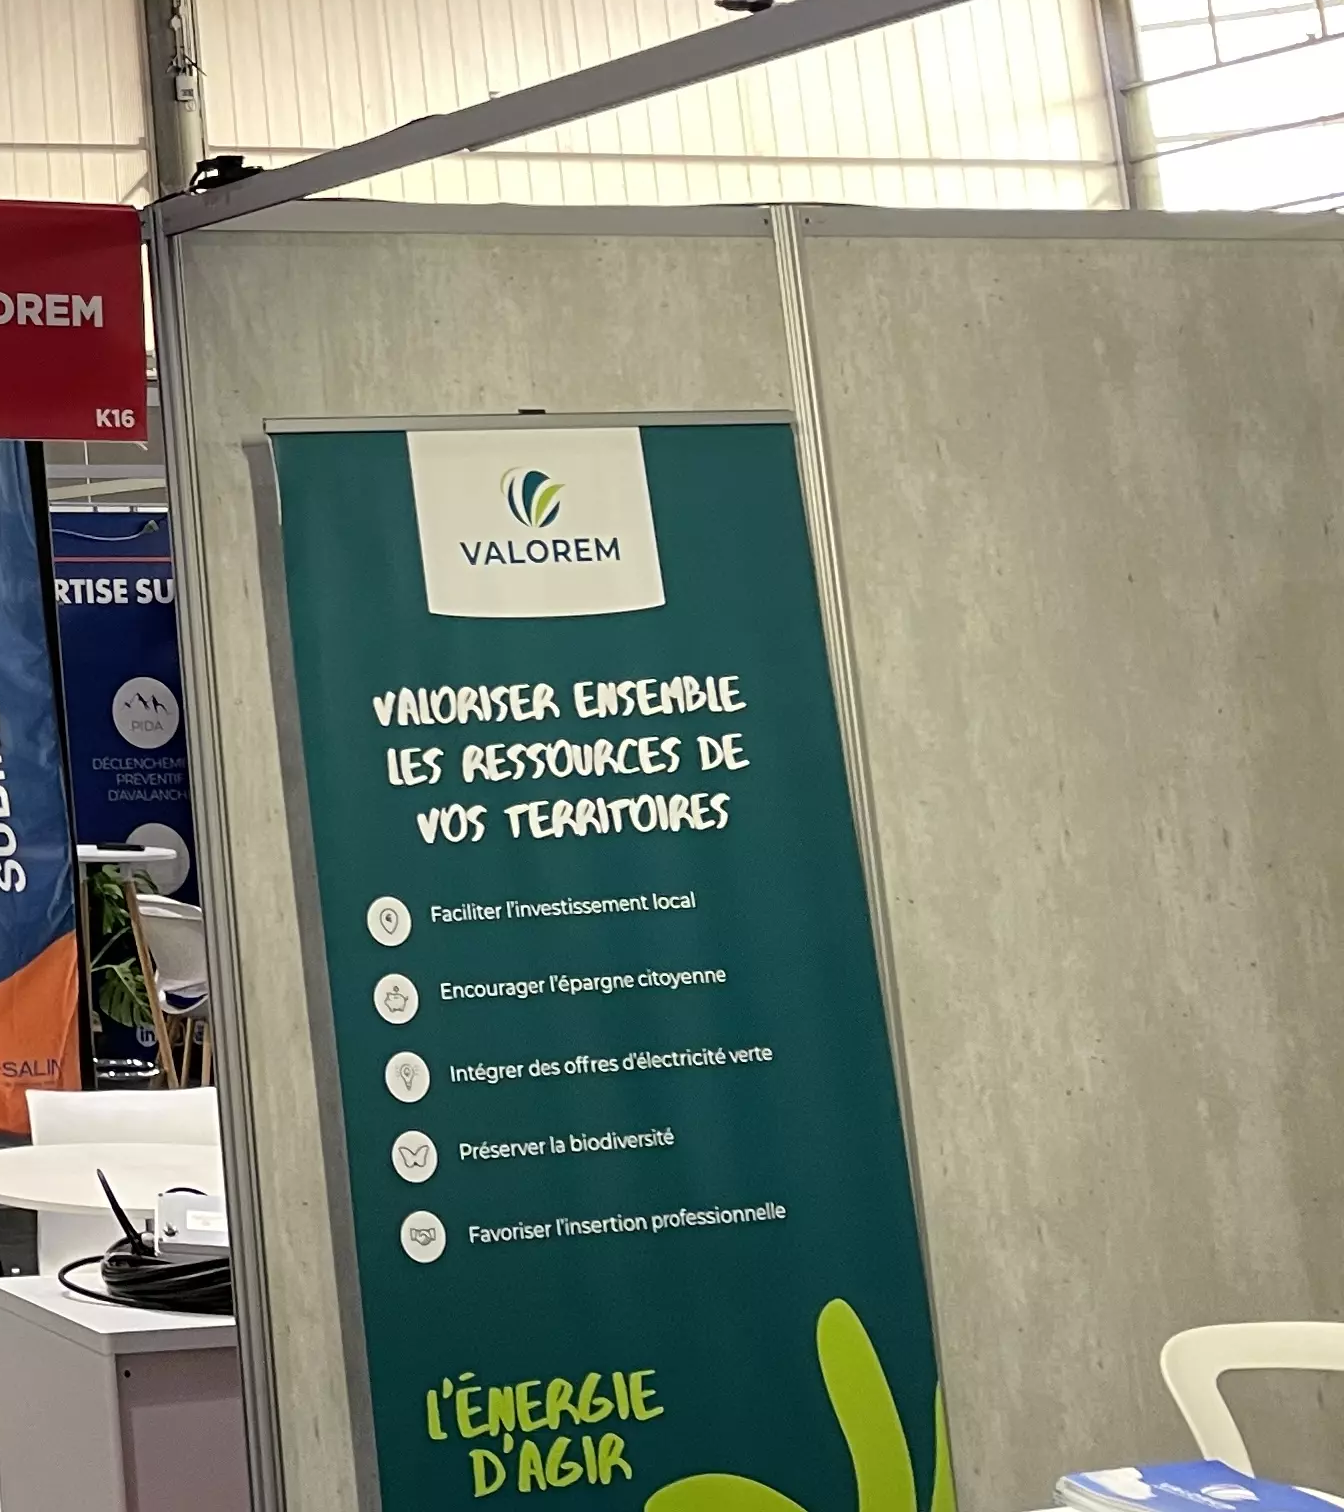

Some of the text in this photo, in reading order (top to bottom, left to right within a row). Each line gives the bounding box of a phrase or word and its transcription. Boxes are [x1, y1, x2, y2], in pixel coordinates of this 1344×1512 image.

[96, 408, 135, 428] K16
[460, 537, 622, 566] VALOREM
[55, 578, 175, 605] RTISE SU
[373, 675, 747, 727] VALORISER ENSEMBLE
[92, 756, 185, 770] DÉCLENCHEM
[387, 732, 750, 786] LES RESSOURCES DE
[108, 788, 188, 802] D'AVALANCH
[417, 791, 731, 844] VOS TERRITOIRES
[430, 892, 697, 923] Faciliter l'investissement local
[440, 966, 727, 1002] Encourager l'épargne citoyenne
[450, 1045, 773, 1085] Intégrer des offres d'électricité verte
[459, 1127, 675, 1161] Préserver la biodiversité
[468, 1201, 786, 1245] Favoriser l'insertion professionnelle
[468, 1432, 633, 1498] D'AGIR
